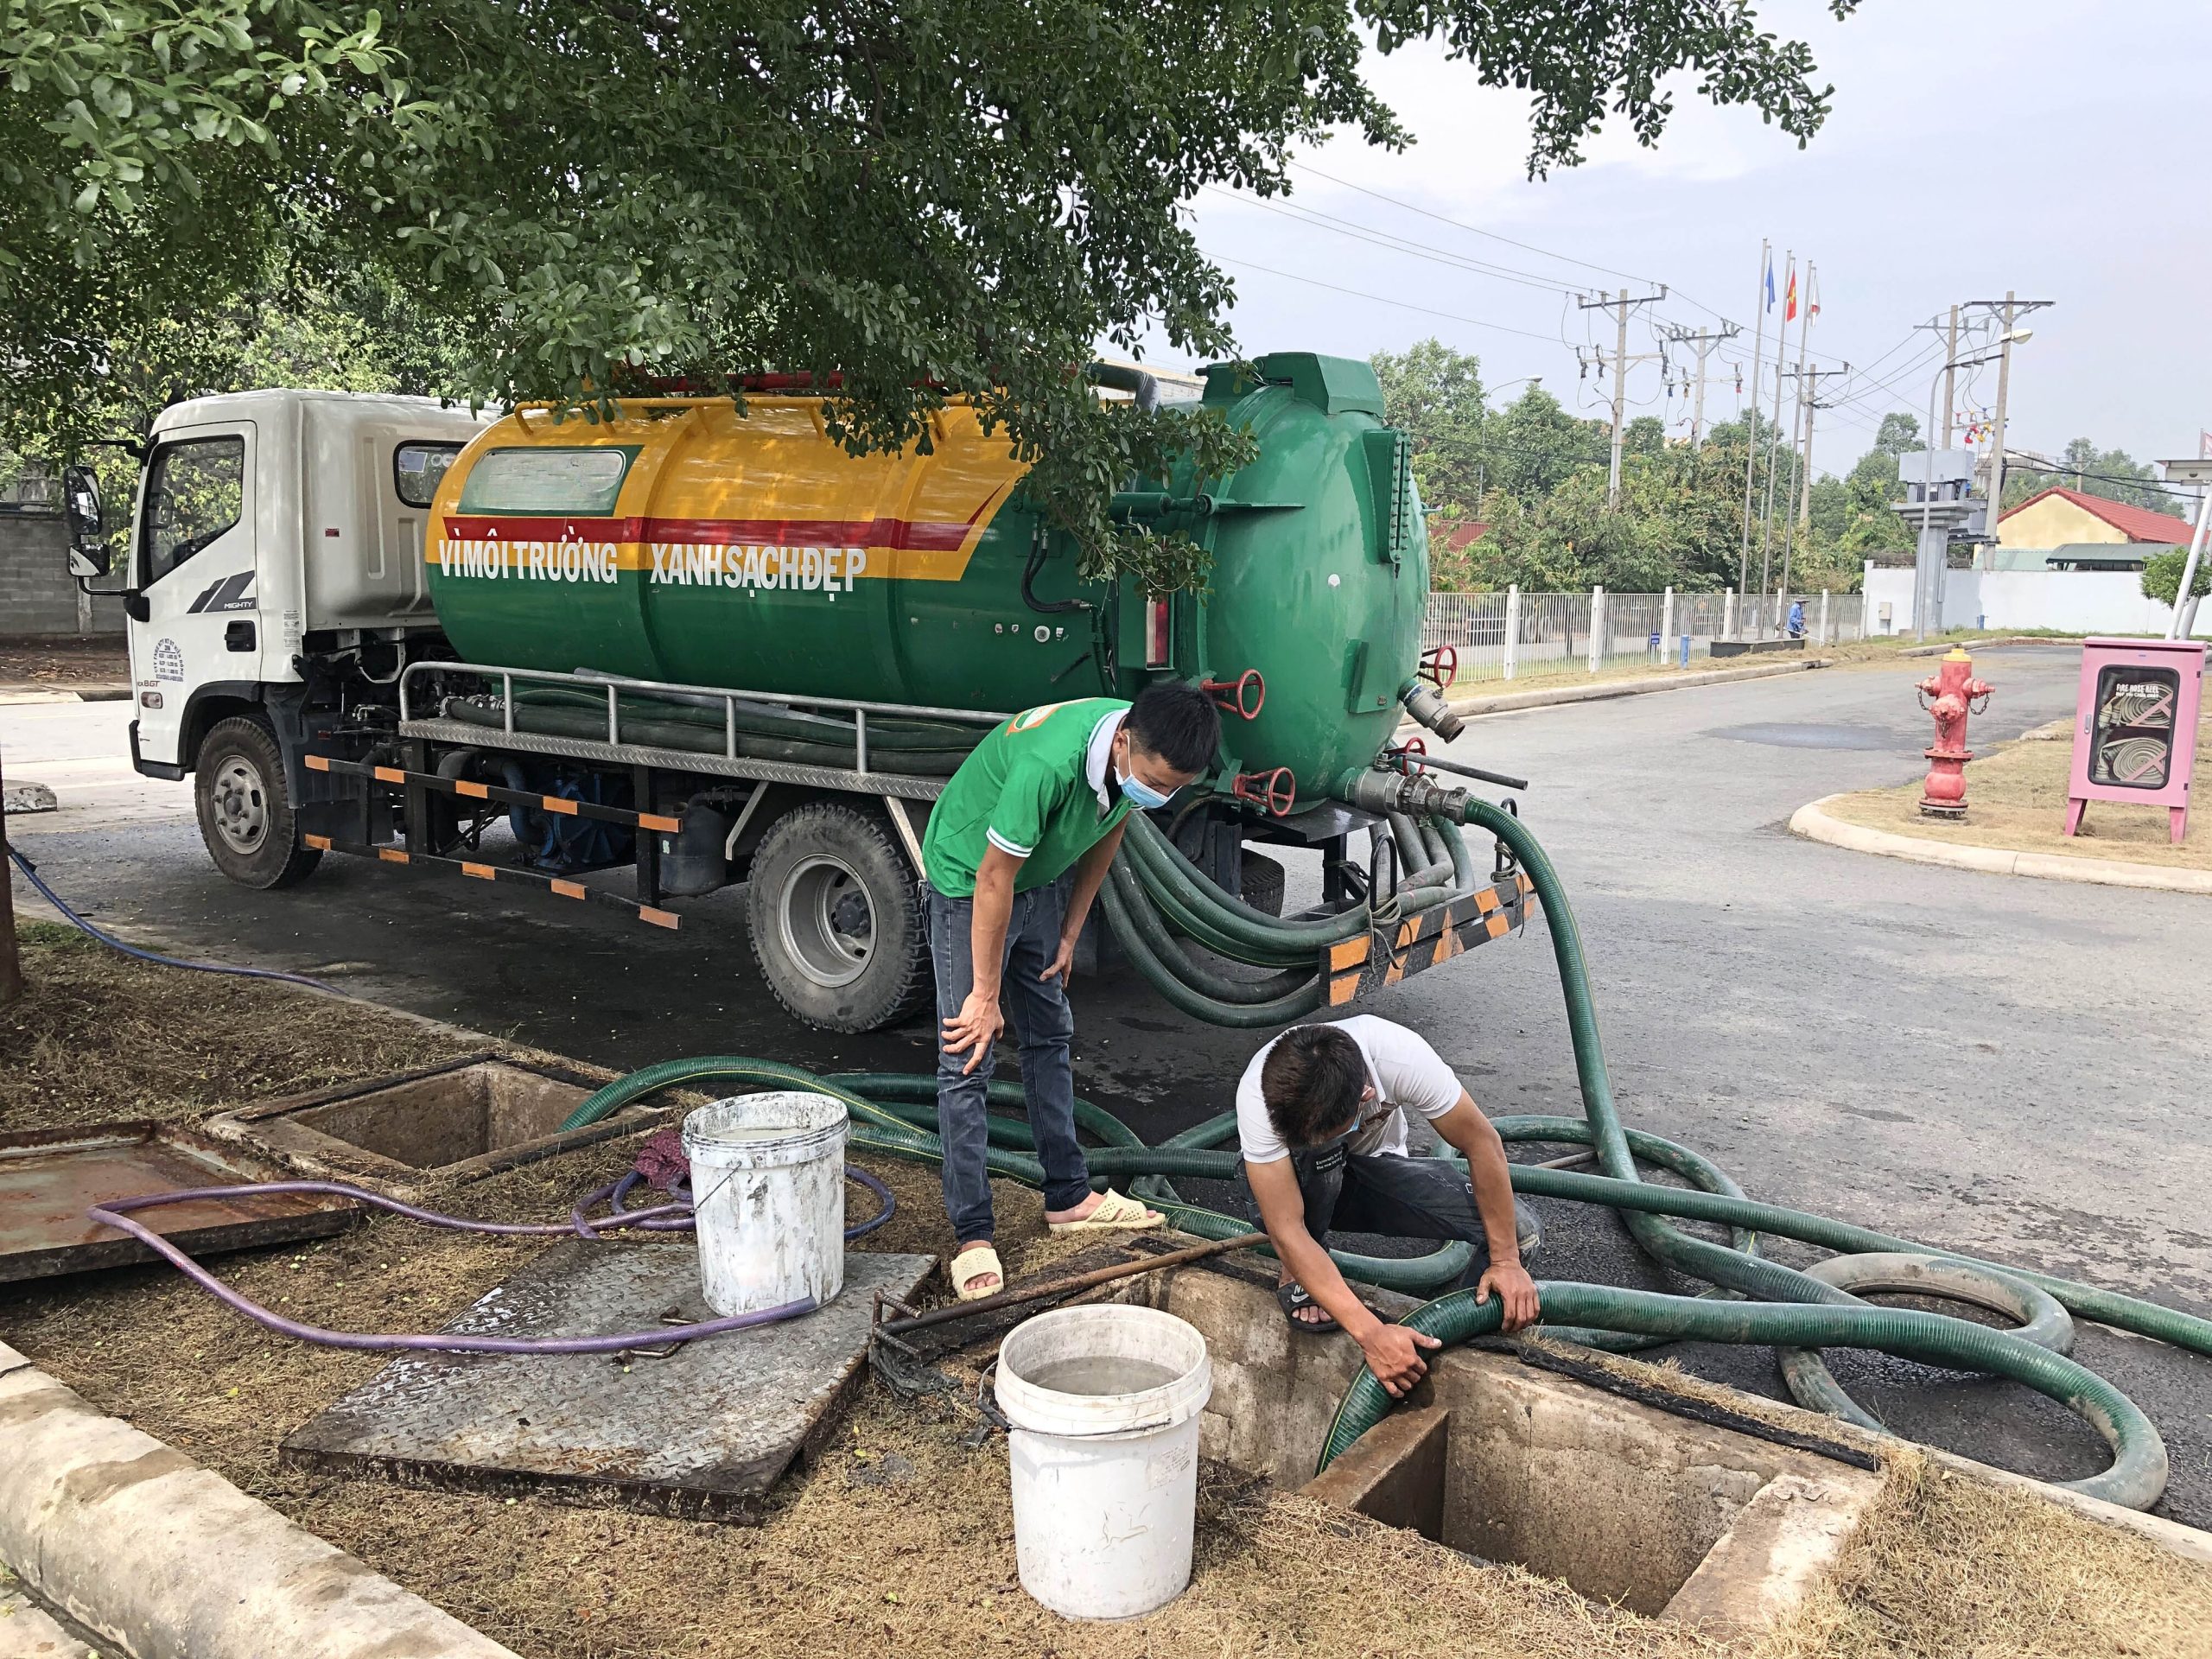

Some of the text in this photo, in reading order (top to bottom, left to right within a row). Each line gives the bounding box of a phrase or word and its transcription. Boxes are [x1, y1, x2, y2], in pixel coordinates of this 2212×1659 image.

[463, 528, 509, 580] MÔI
[513, 526, 618, 584] TRƯỜNG
[650, 543, 722, 587] XANH
[724, 545, 798, 597] SẠCH
[801, 547, 867, 601] ĐẸP
